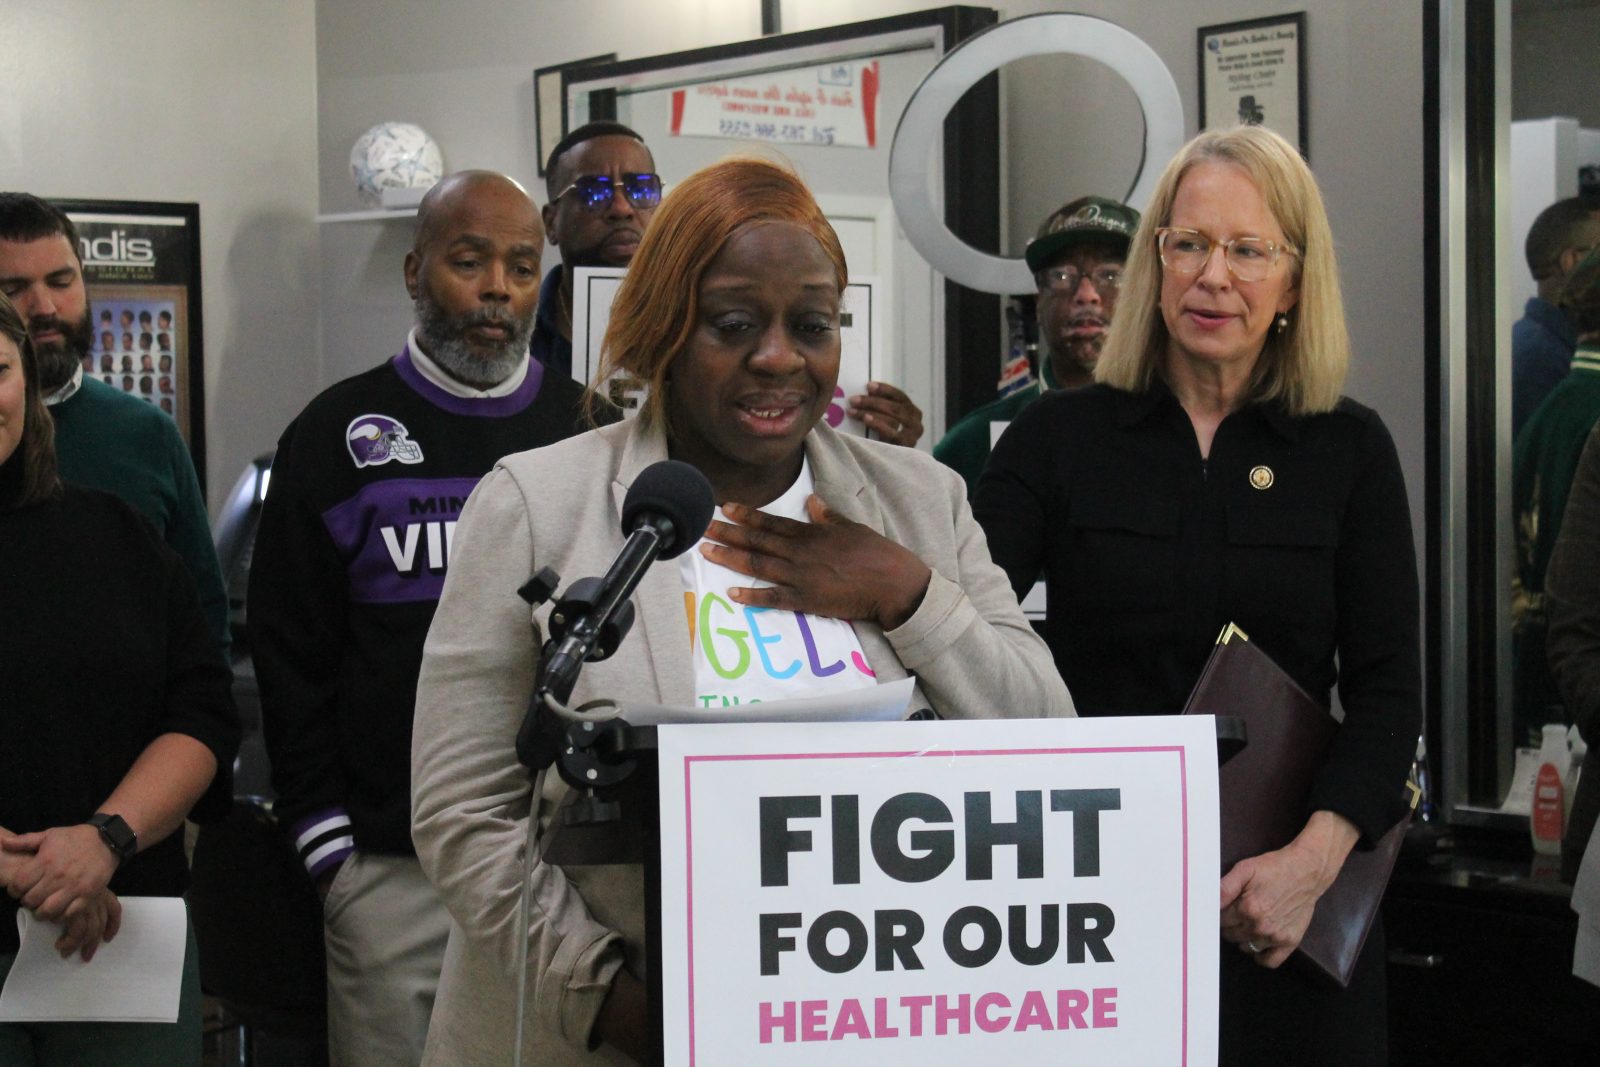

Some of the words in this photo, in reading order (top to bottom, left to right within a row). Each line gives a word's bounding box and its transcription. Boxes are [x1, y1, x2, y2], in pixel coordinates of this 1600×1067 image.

[759, 788, 1121, 887] FIGHT
[759, 908, 925, 976] FOR
[943, 902, 1116, 968] OUR
[759, 987, 1118, 1044] HEALTHCARE
